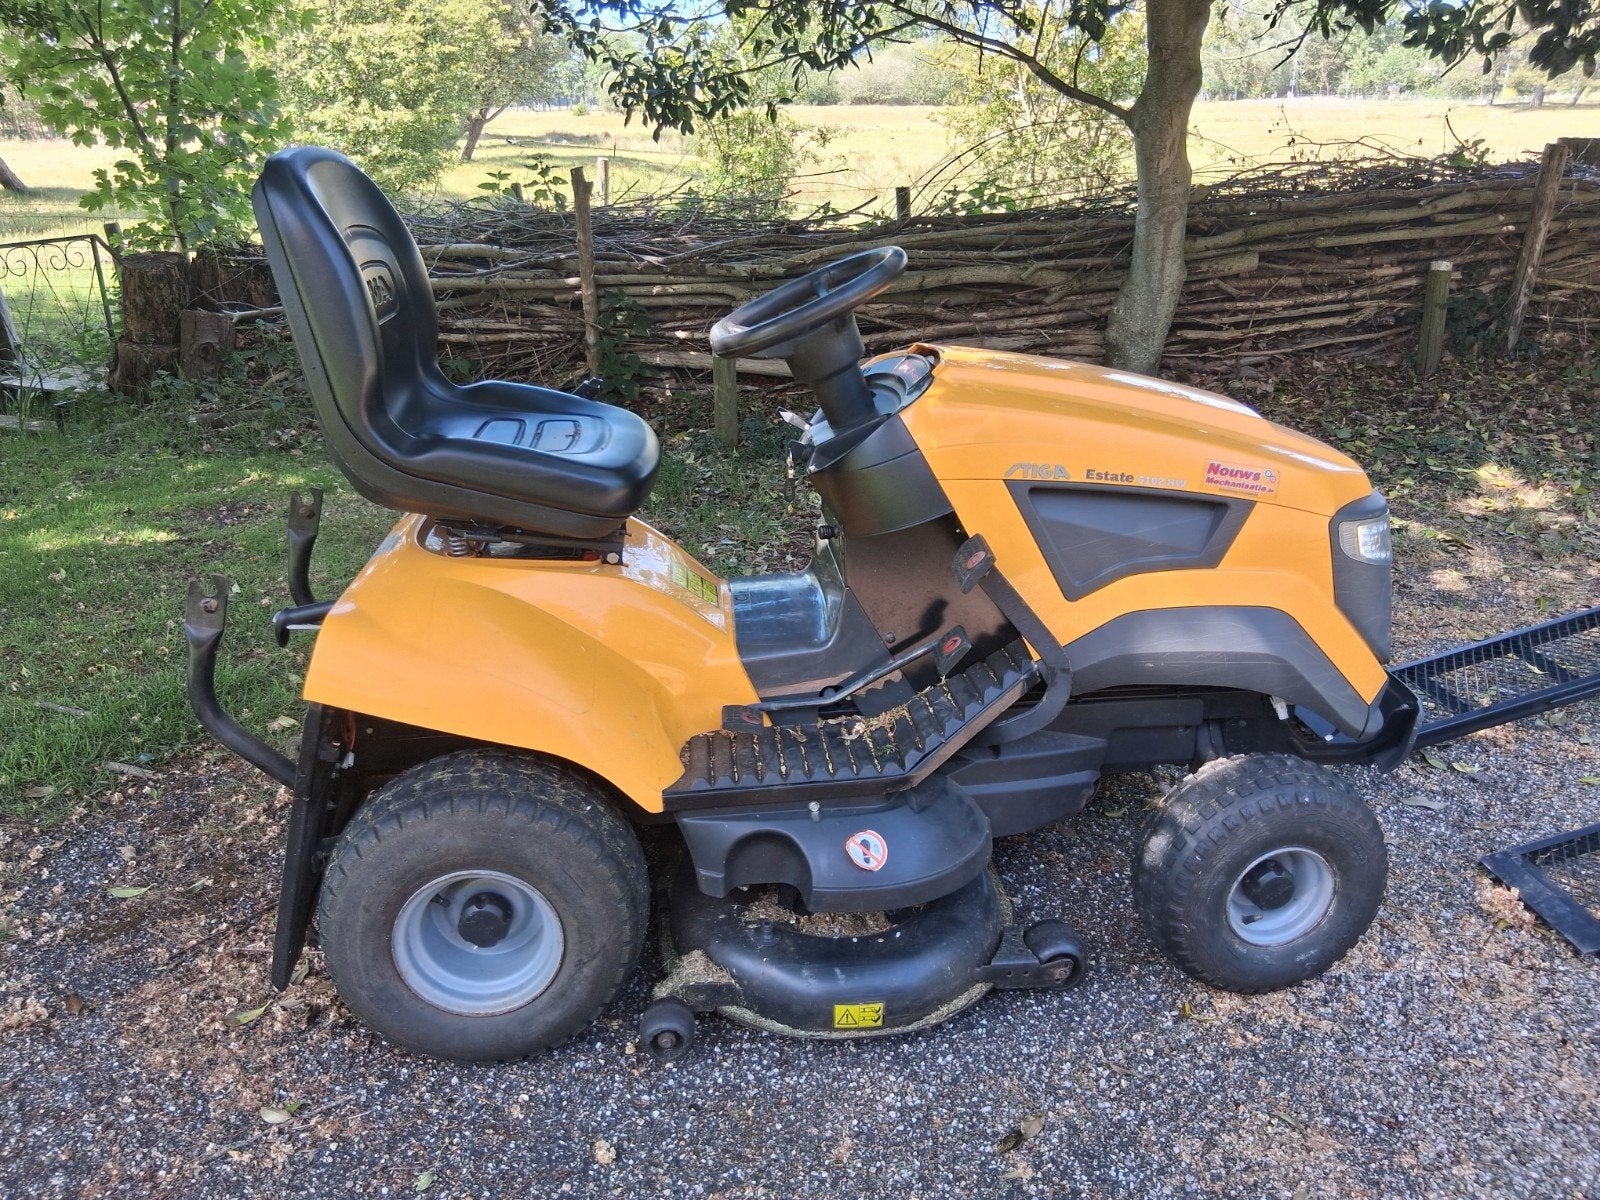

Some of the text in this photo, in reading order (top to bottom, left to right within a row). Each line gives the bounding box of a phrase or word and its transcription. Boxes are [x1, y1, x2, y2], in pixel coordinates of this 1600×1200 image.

[1004, 462, 1070, 480] STIGA
[1085, 468, 1135, 483] Estate
[1206, 462, 1262, 482] Nouws
[1205, 476, 1267, 493] Mechanisatie
